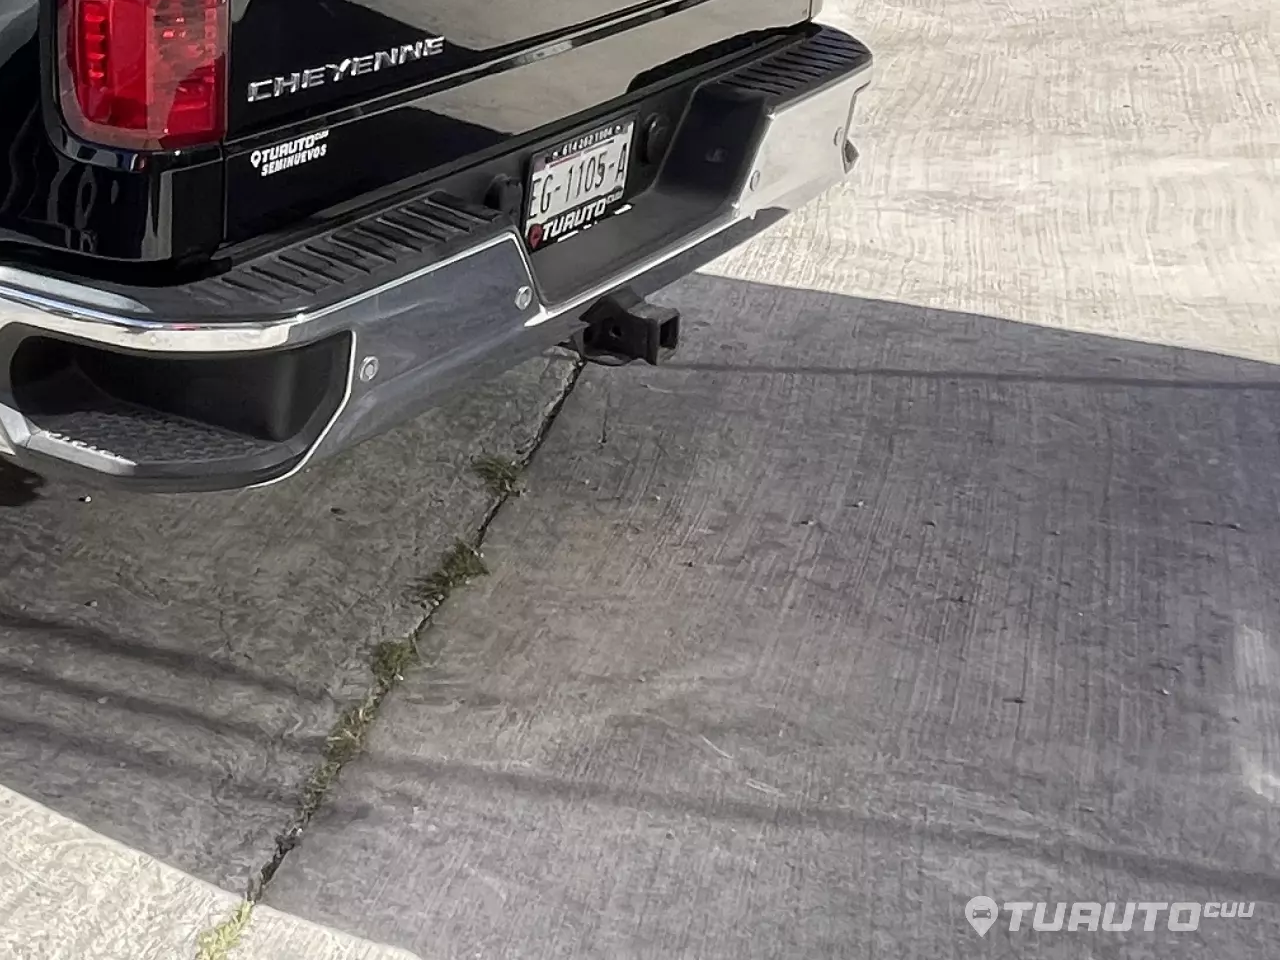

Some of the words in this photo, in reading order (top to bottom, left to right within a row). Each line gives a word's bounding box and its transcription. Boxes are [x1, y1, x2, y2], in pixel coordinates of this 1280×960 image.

[247, 36, 446, 102] CHEYENNE
[261, 134, 315, 164] TUAUTO
[261, 143, 328, 177] SEMINUEVOS
